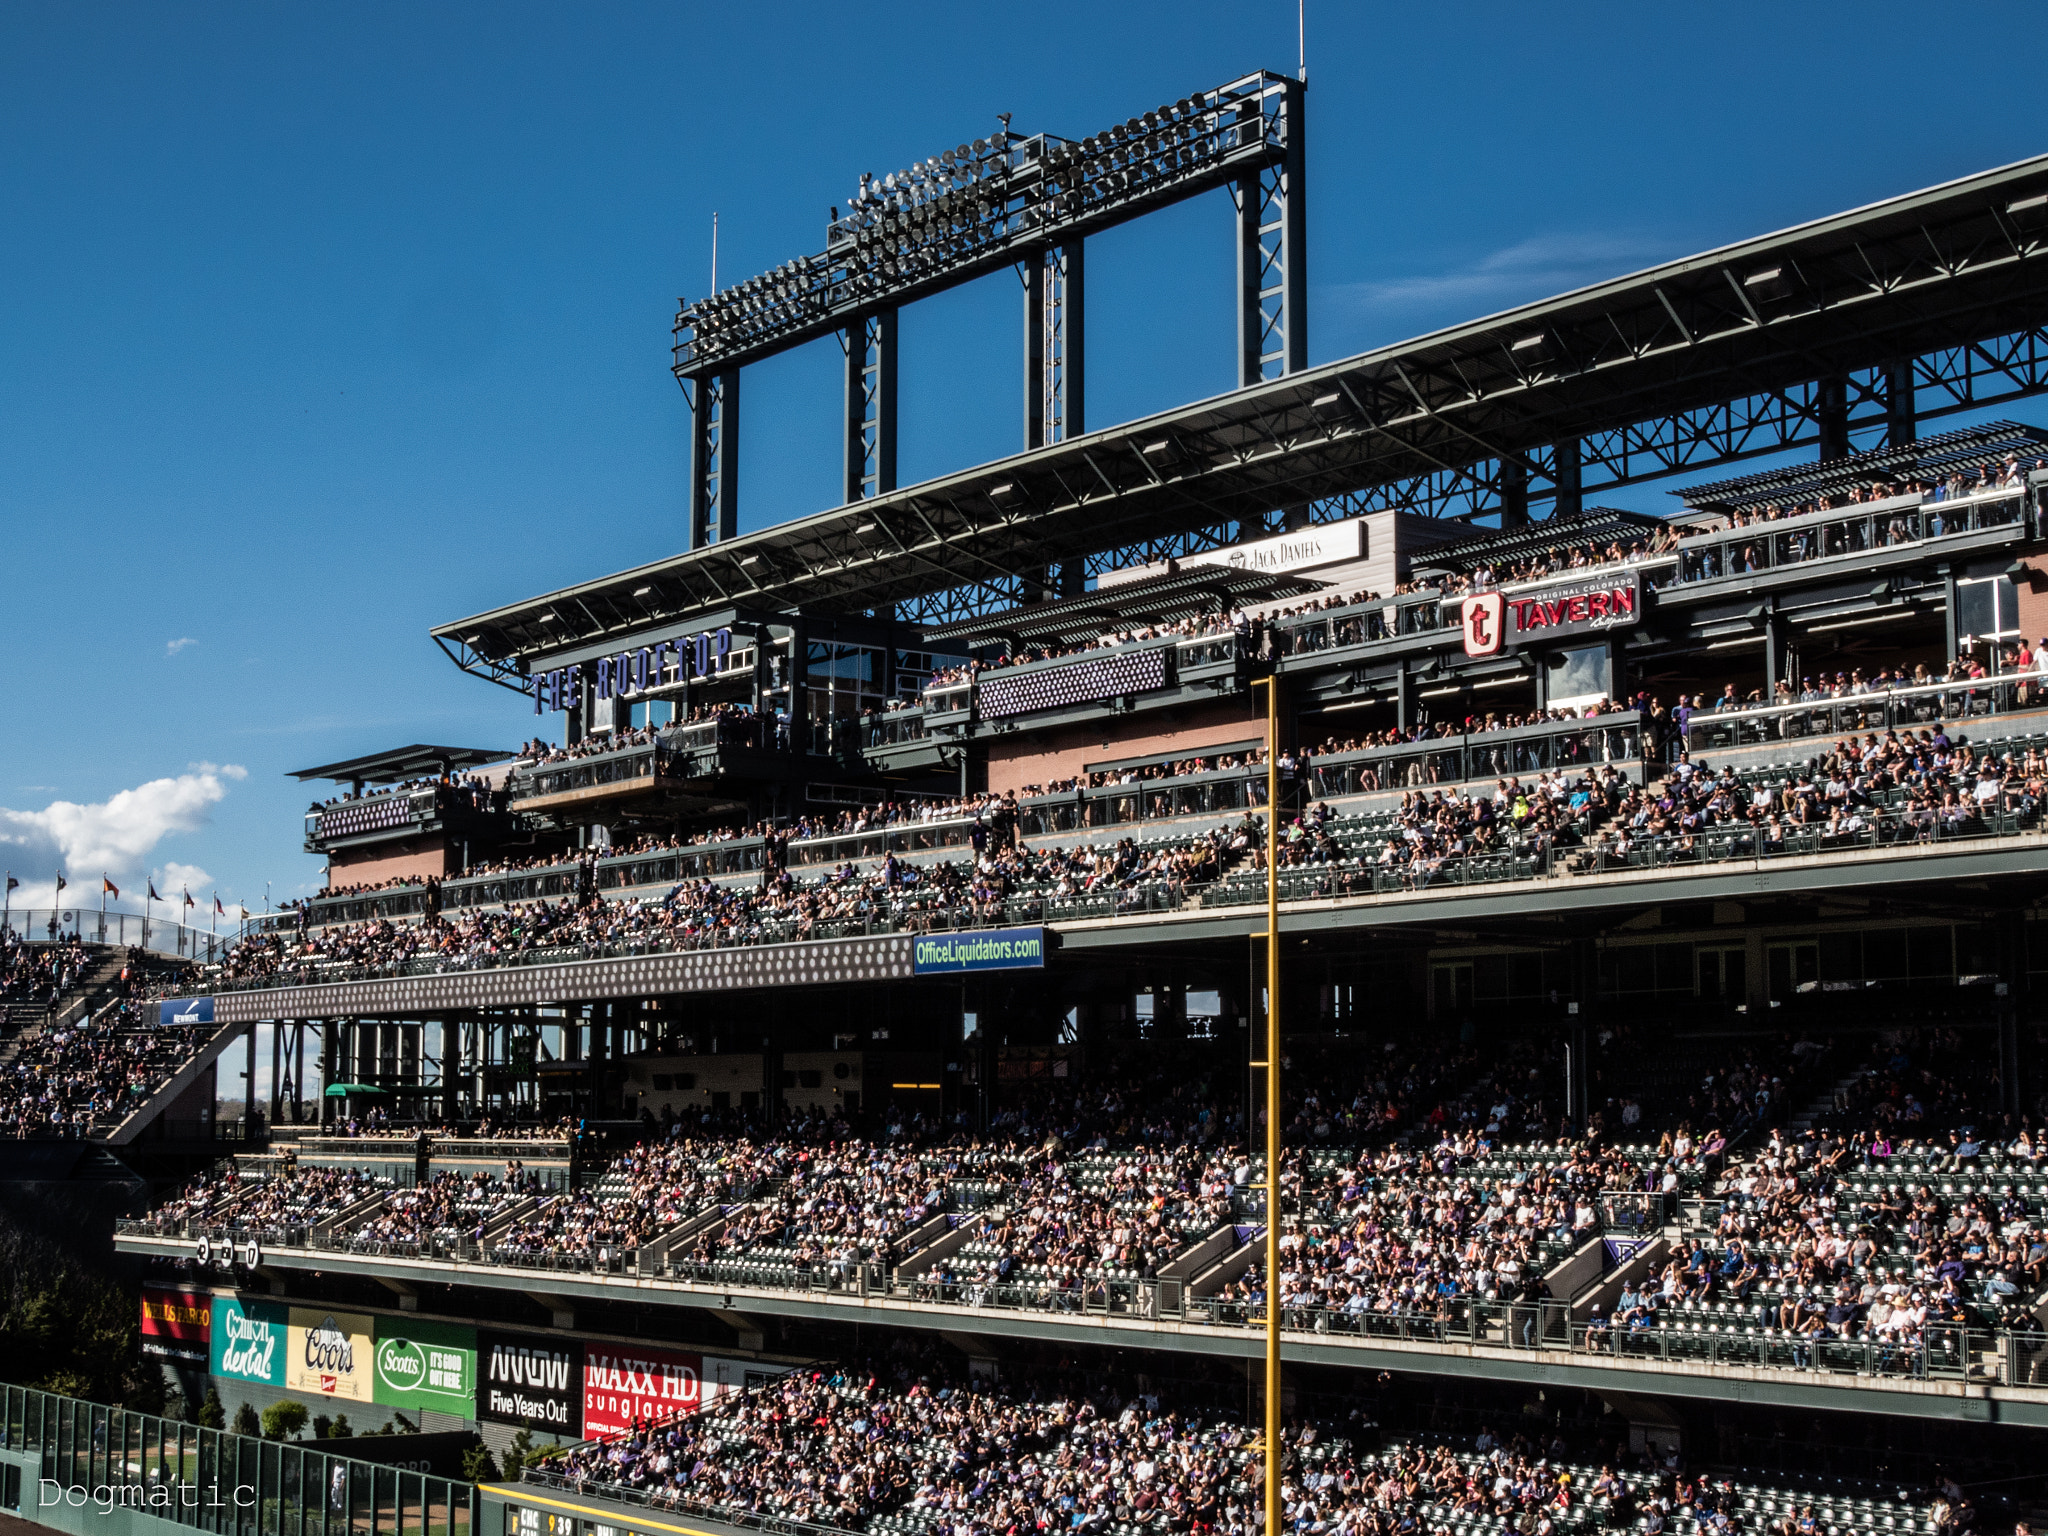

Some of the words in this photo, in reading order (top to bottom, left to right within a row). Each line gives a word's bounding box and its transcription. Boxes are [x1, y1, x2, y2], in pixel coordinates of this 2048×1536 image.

[1250, 549, 1277, 570] JACK
[1535, 587, 1580, 601] ORIGINAL
[1583, 577, 1633, 593] COLORADO
[1507, 585, 1636, 632] TAVERN
[531, 663, 582, 716] THE
[597, 627, 733, 700] ROOFTOP
[916, 937, 1040, 967] OfficeLiquidators.com
[143, 1301, 176, 1322] WELLS
[177, 1306, 210, 1327] FARGO
[226, 1305, 269, 1342] Comfort
[222, 1335, 275, 1380] dental
[305, 1326, 354, 1375] Coors
[384, 1349, 419, 1375] Scotts
[443, 1353, 462, 1372] GOOD
[429, 1369, 443, 1387] OUT
[587, 1353, 658, 1397] MAXX
[490, 1389, 514, 1414] Five
[513, 1393, 545, 1419] Years
[546, 1399, 568, 1423] Out
[520, 1508, 539, 1527] CHC
[557, 1516, 572, 1535] 39
